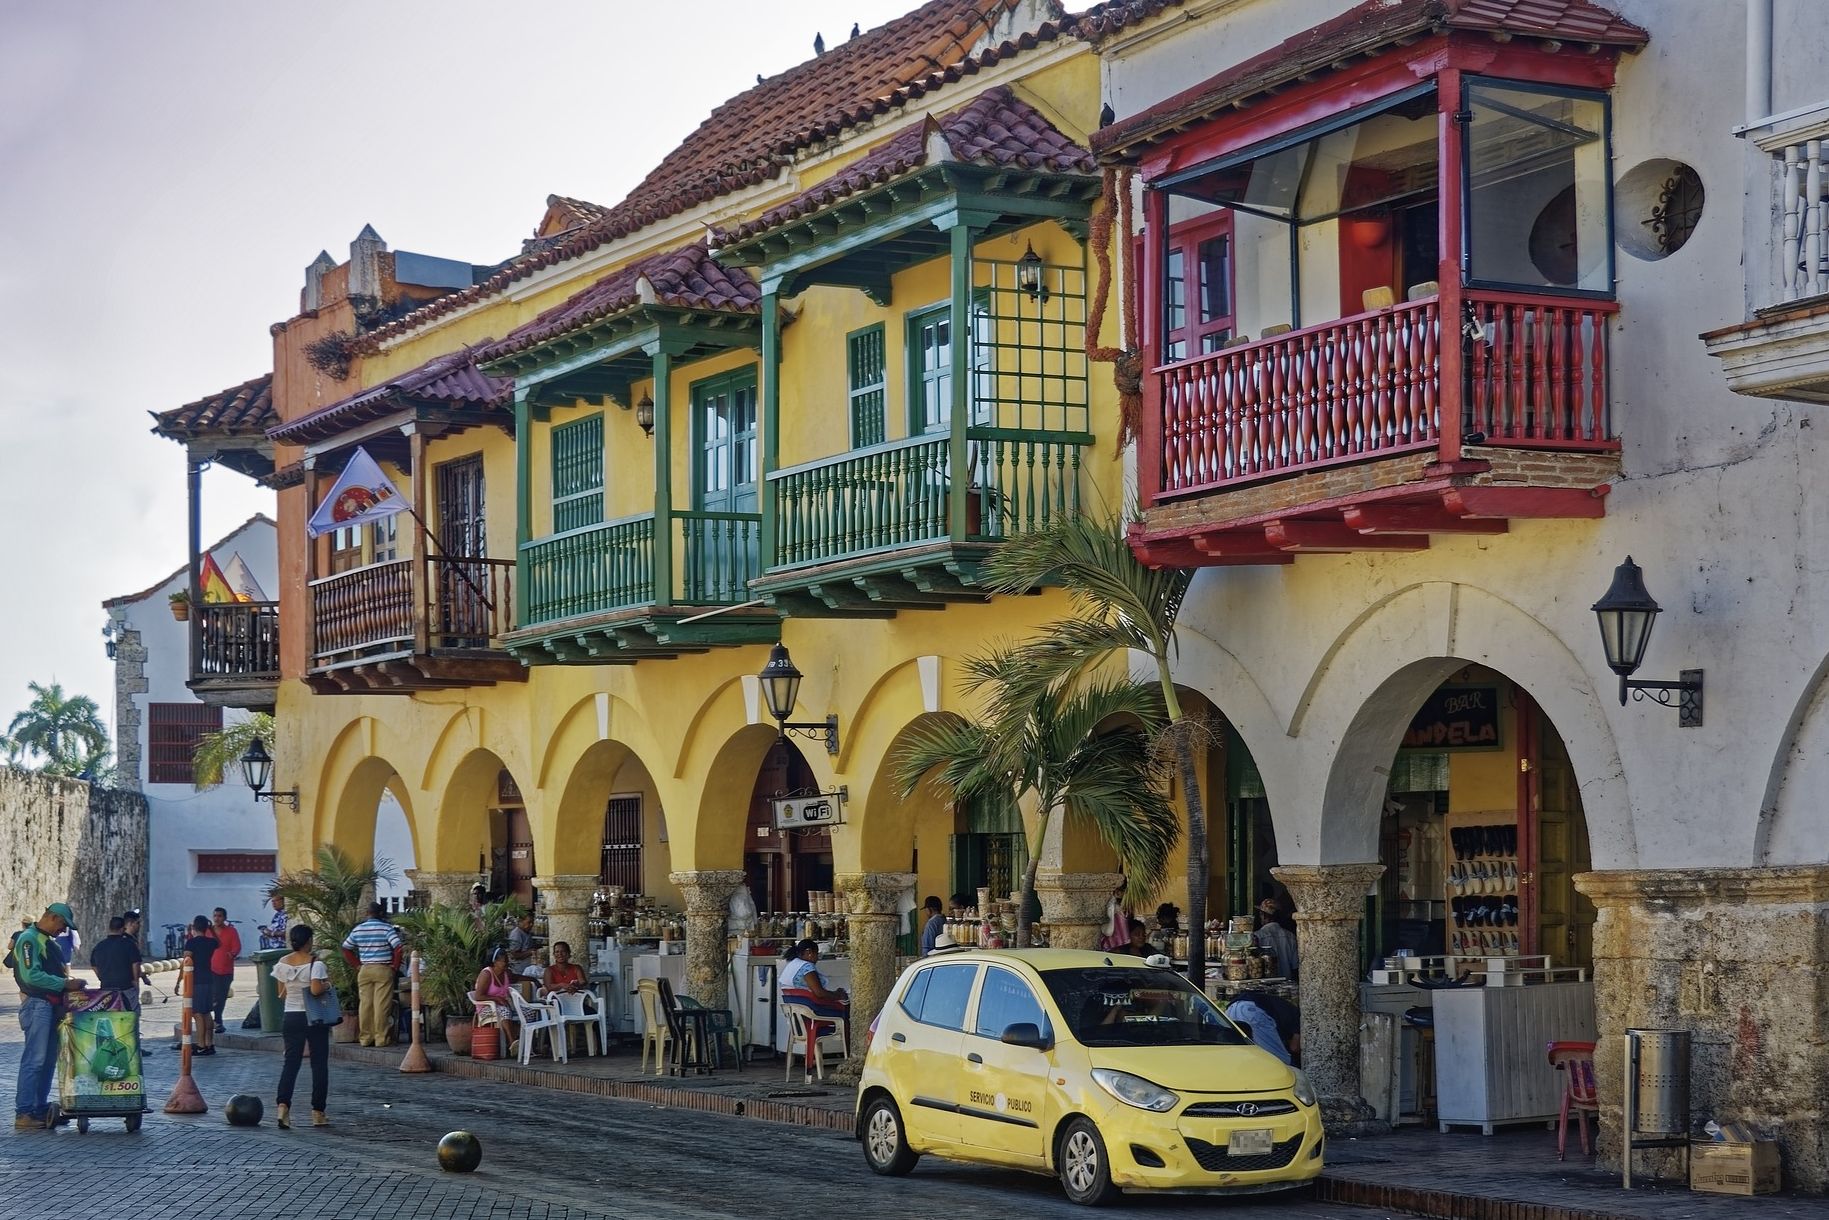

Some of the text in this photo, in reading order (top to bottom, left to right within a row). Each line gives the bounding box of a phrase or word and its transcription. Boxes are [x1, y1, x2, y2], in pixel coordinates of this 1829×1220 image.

[1444, 691, 1487, 714] BAR
[104, 1082, 139, 1091] $1.500
[970, 1090, 1032, 1112] SERVICIO PUBLICO
